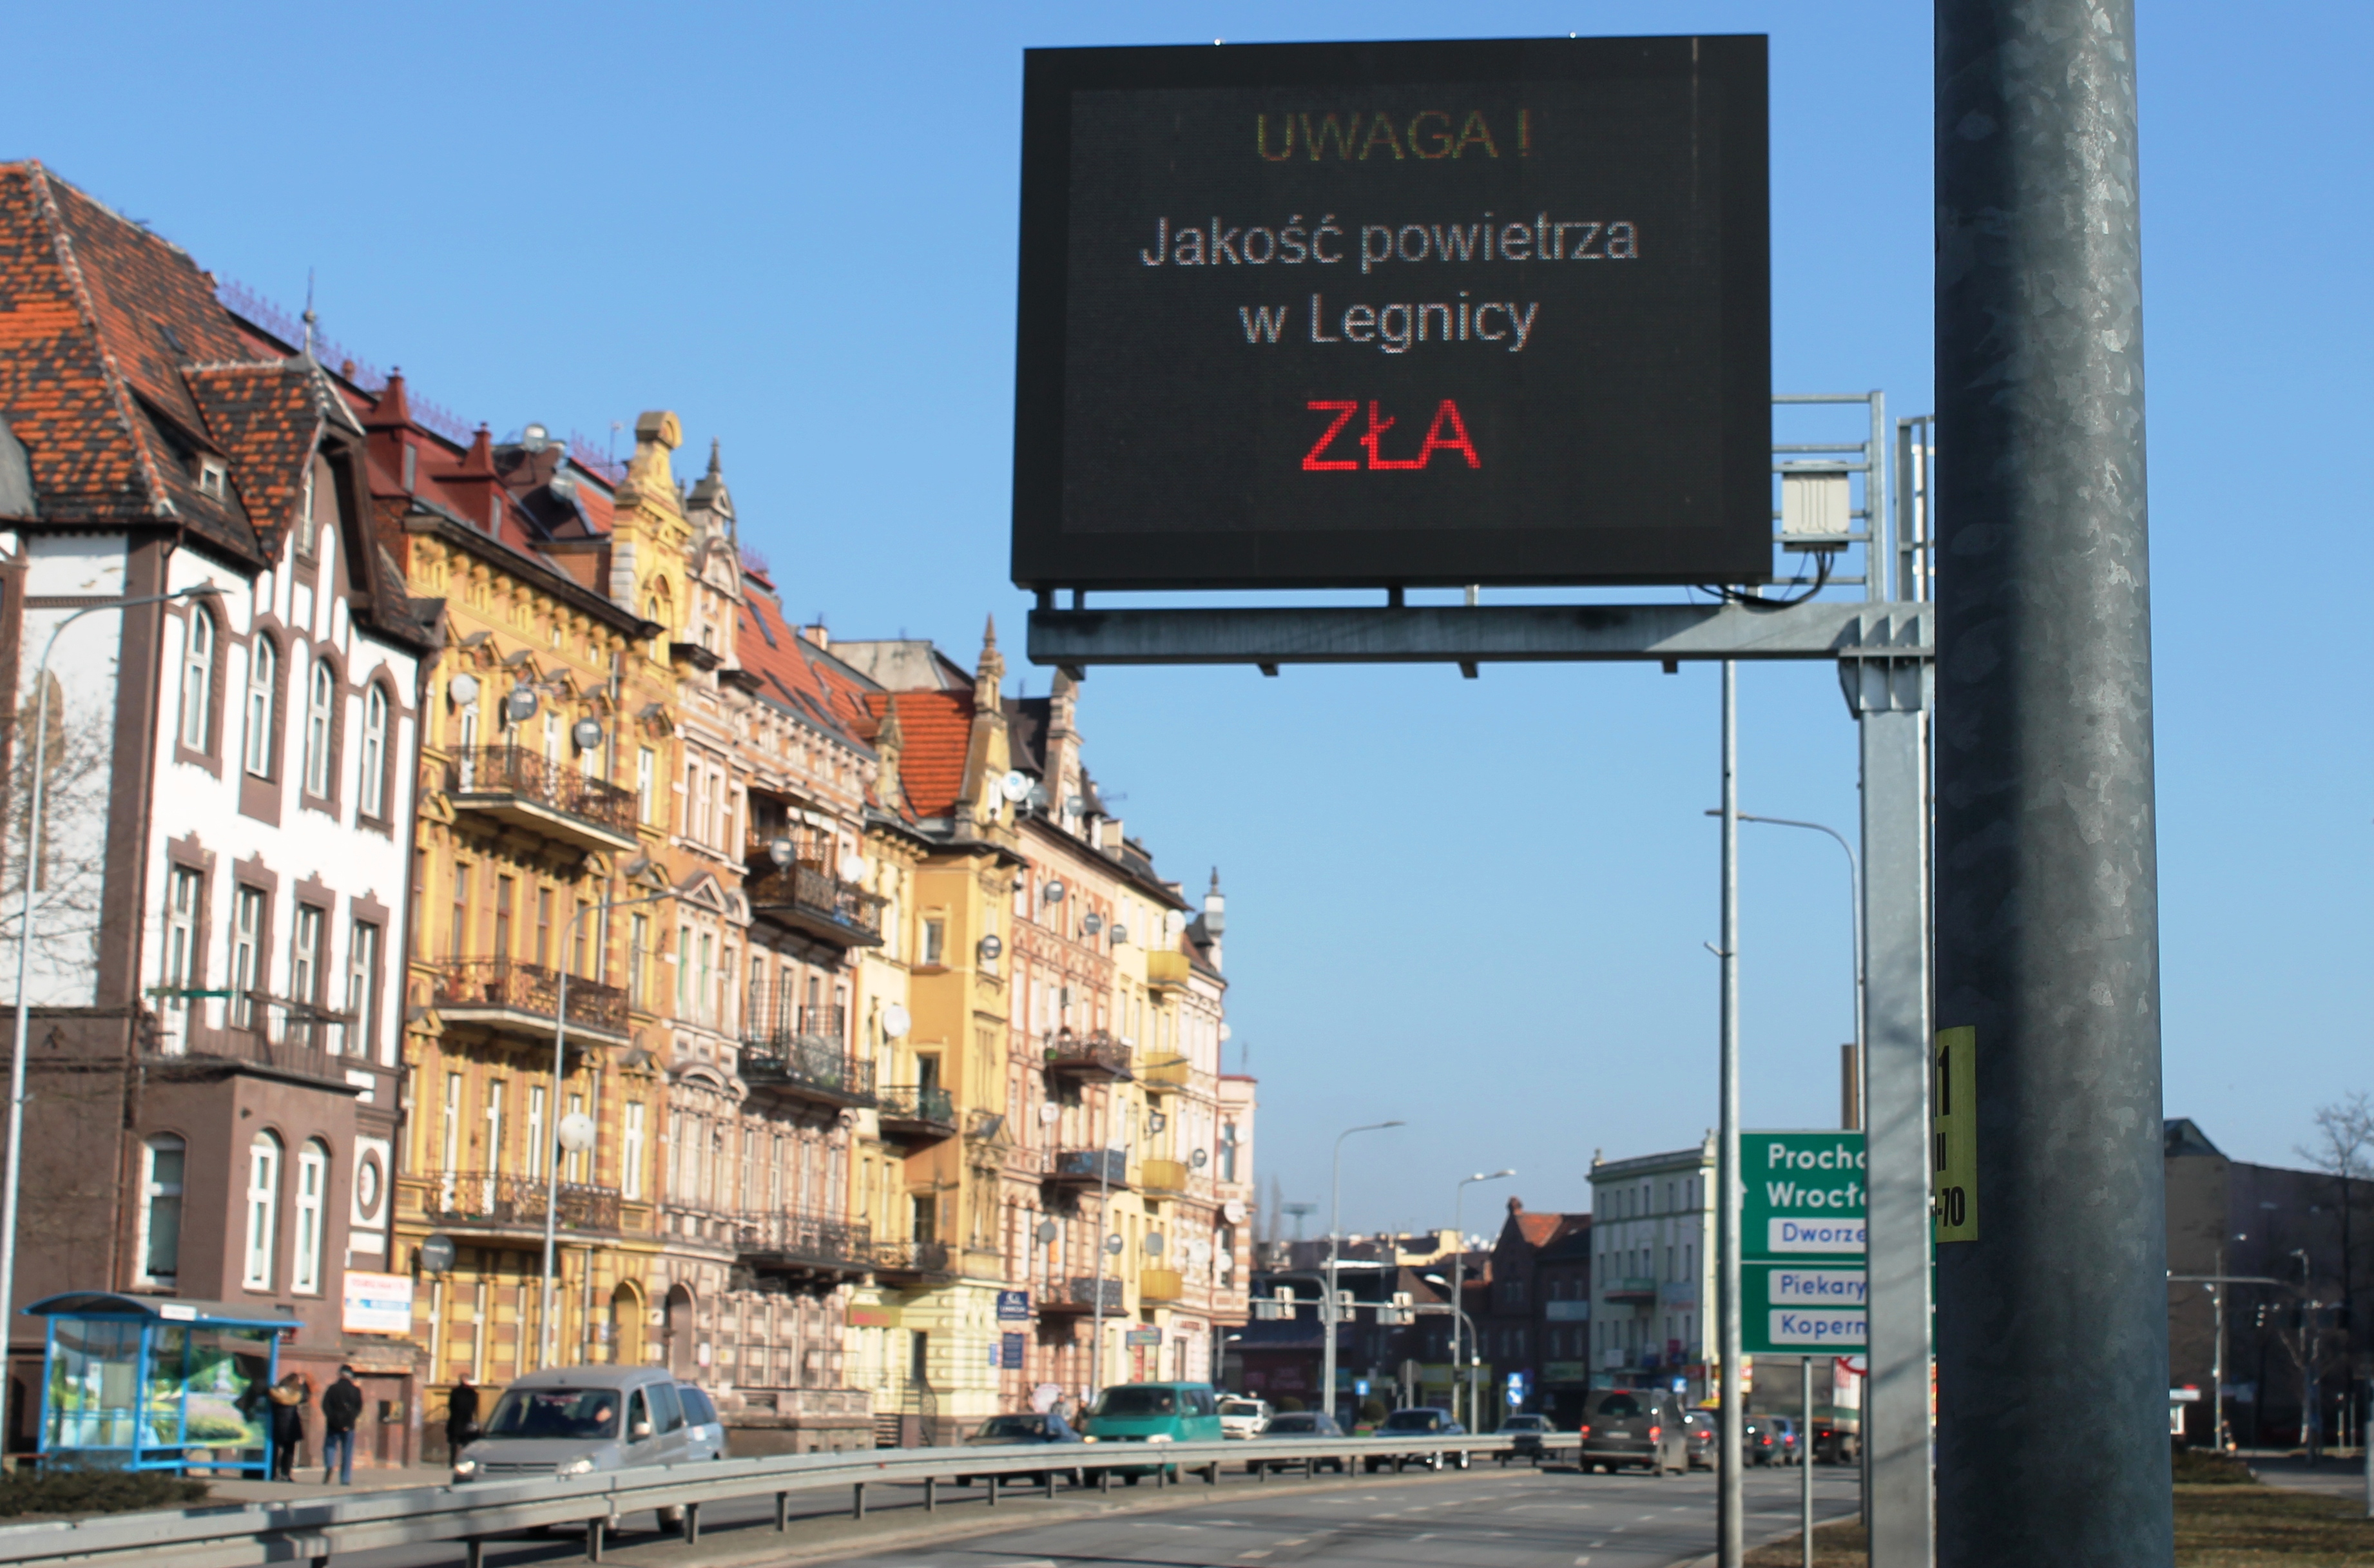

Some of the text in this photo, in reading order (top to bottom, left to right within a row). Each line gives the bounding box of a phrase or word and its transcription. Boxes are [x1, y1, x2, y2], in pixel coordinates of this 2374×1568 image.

[1257, 110, 1530, 161] UWAGA !
[1140, 212, 1639, 273] Jakość powietrza
[1239, 291, 1539, 353] w Legnicy
[1301, 399, 1481, 471] ZŁA
[1935, 1045, 1950, 1118] 1
[1935, 1186, 1965, 1227] -70
[1781, 1275, 1867, 1301] Piekary
